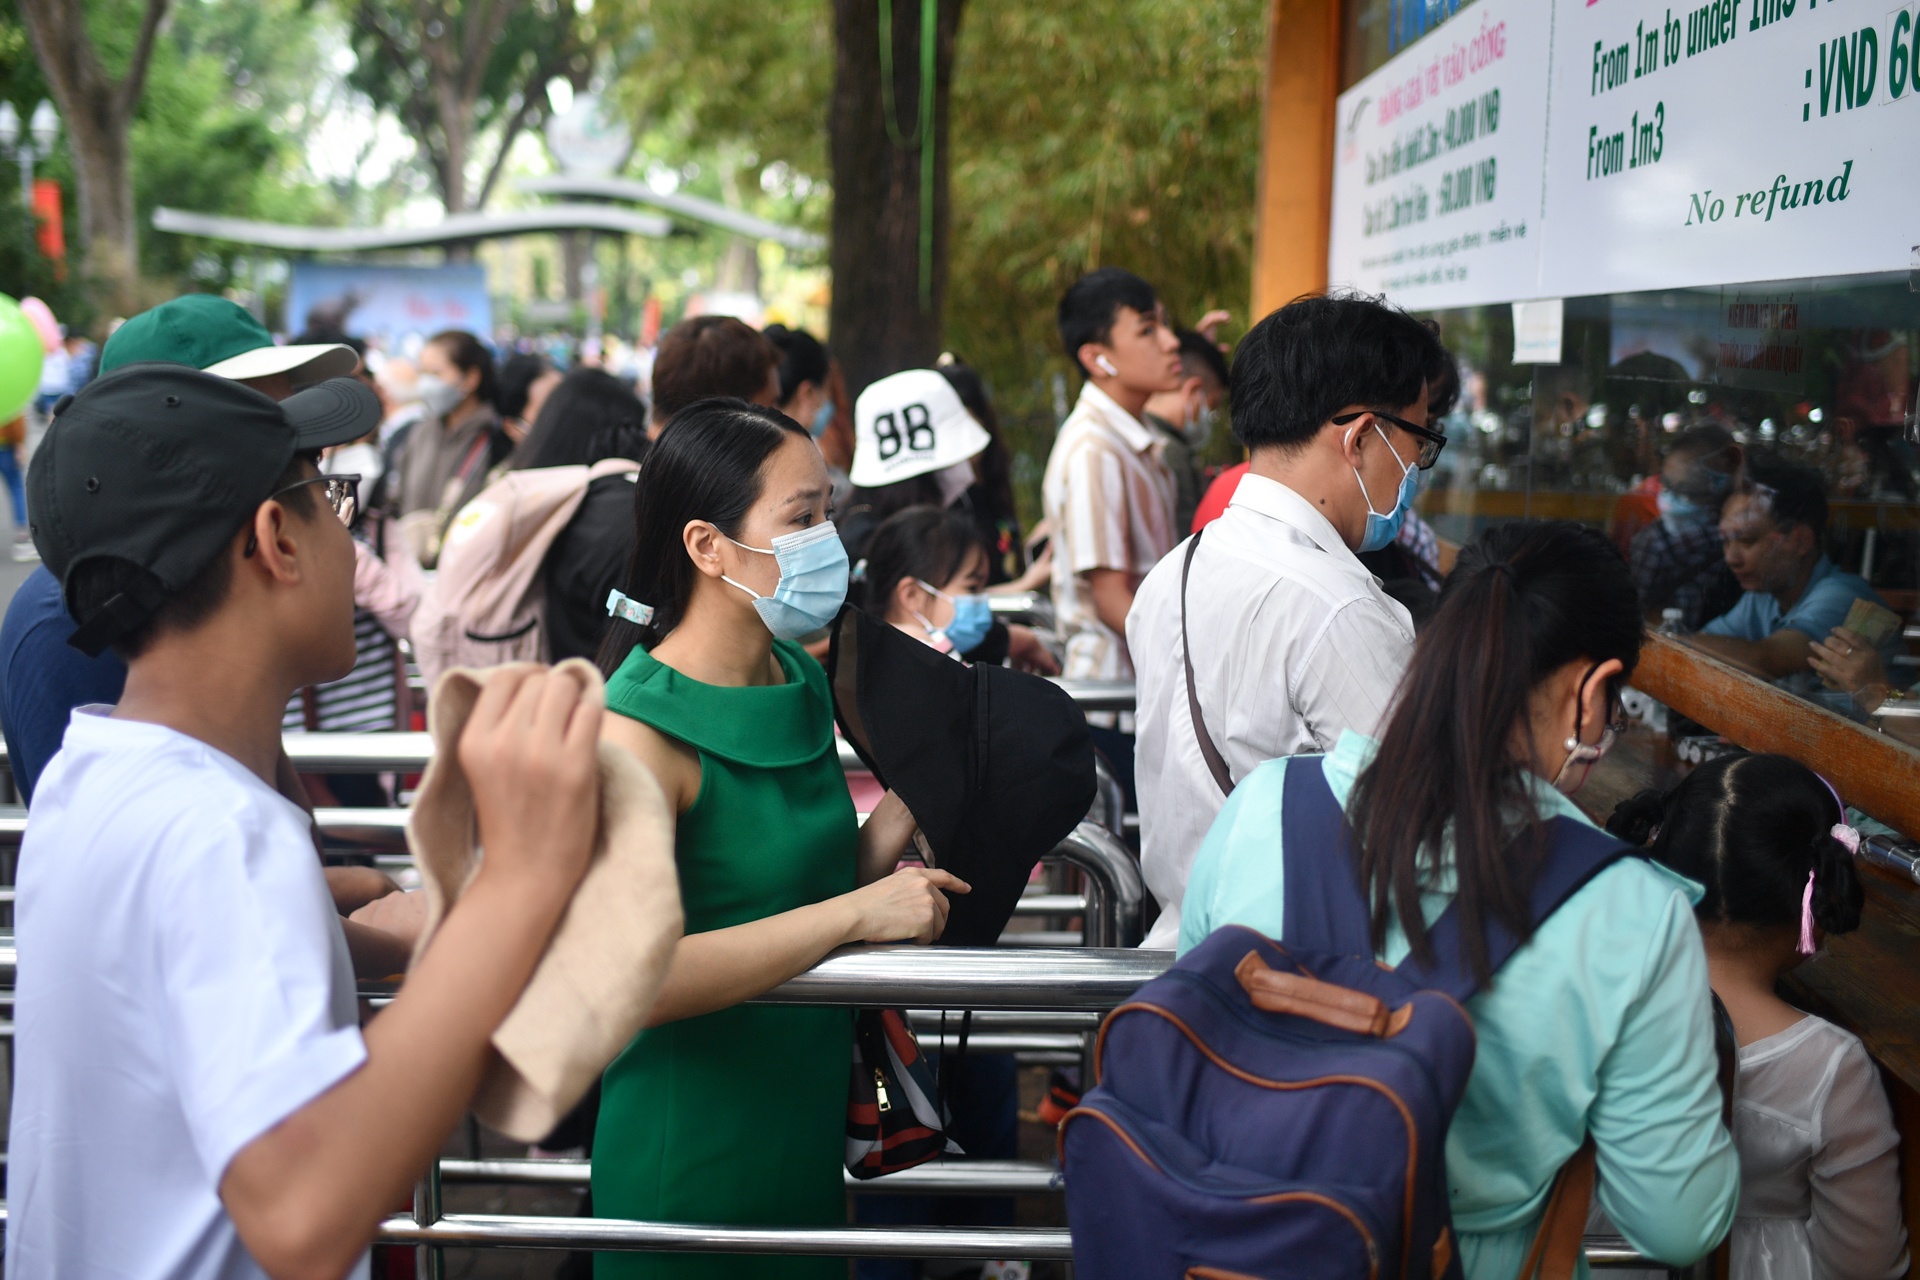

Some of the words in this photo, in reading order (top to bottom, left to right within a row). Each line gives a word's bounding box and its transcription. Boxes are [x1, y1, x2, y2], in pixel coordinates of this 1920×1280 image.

[1592, 40, 1629, 97] From
[1634, 19, 1659, 79] 1m
[1664, 8, 1681, 67] to
[1687, 0, 1741, 58] under
[1587, 124, 1624, 181] From
[1629, 100, 1665, 169] 1m3
[1515, 217, 1527, 239] vé
[1684, 189, 1725, 226] No
[1734, 159, 1854, 222] refund
